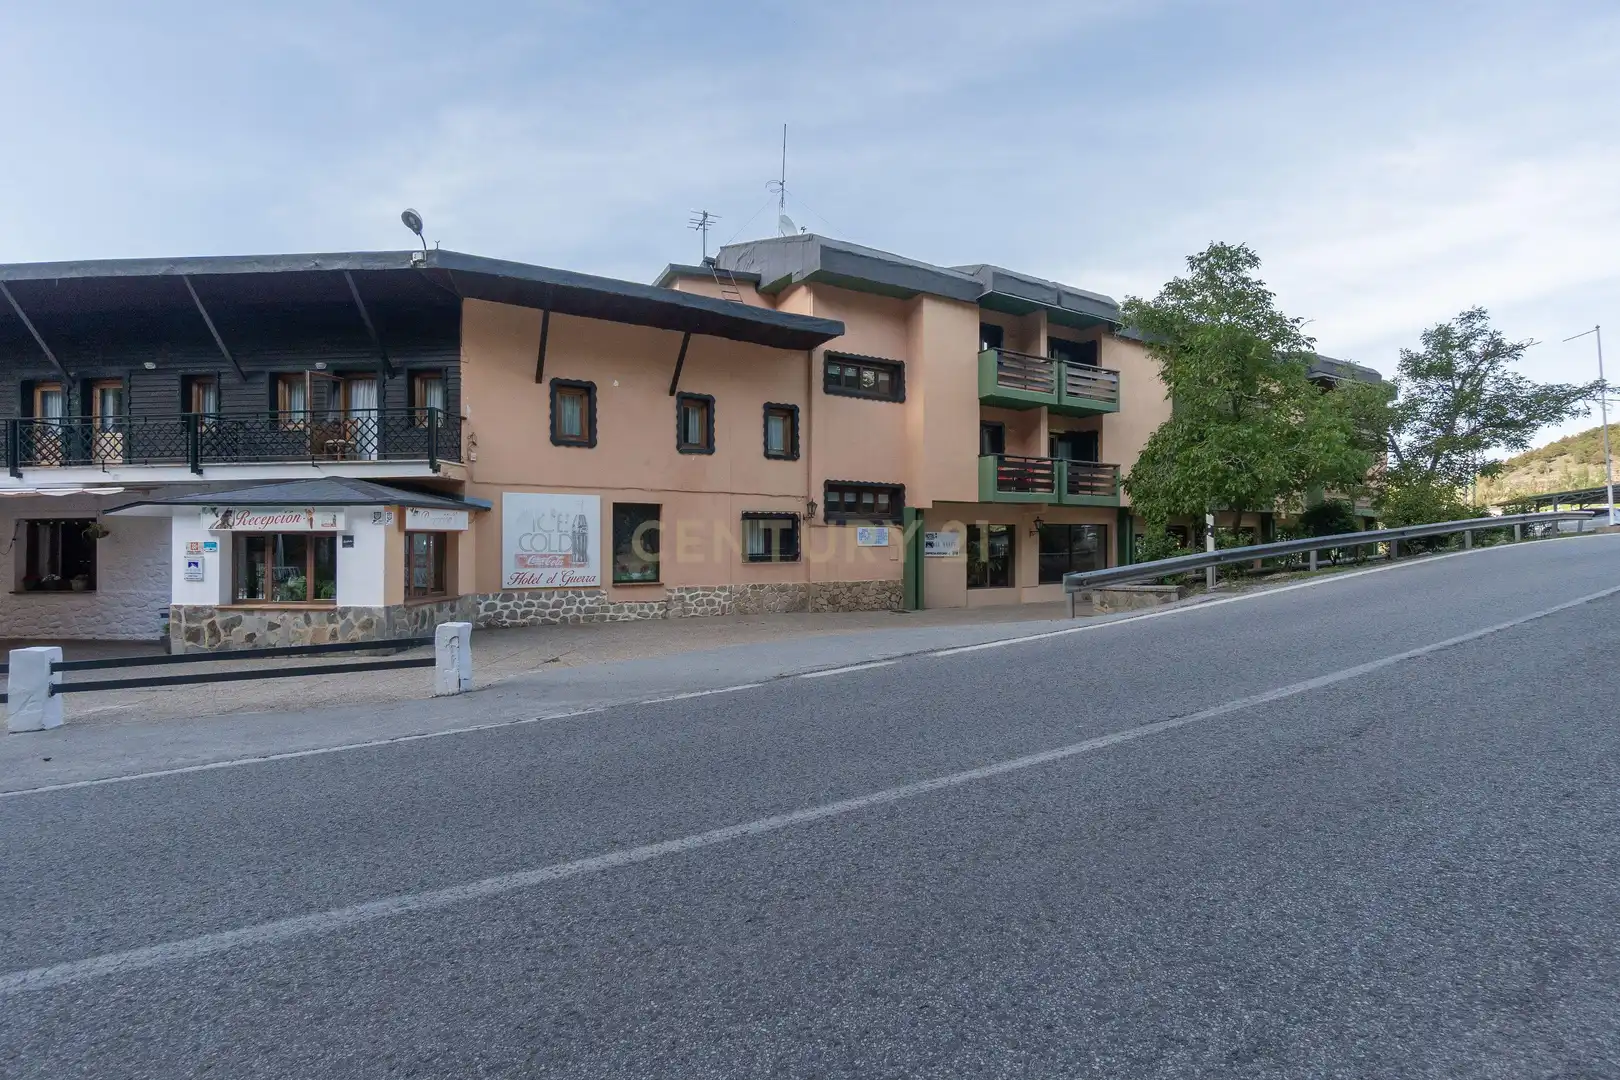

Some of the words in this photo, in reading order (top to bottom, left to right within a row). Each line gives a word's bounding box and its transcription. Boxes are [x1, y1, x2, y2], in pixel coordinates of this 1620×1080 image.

[235, 507, 302, 530] Recepción
[533, 513, 569, 533] ICE
[518, 532, 573, 553] COLD
[508, 572, 543, 585] Hotel
[546, 572, 558, 584] el
[559, 570, 596, 587] Guerra
